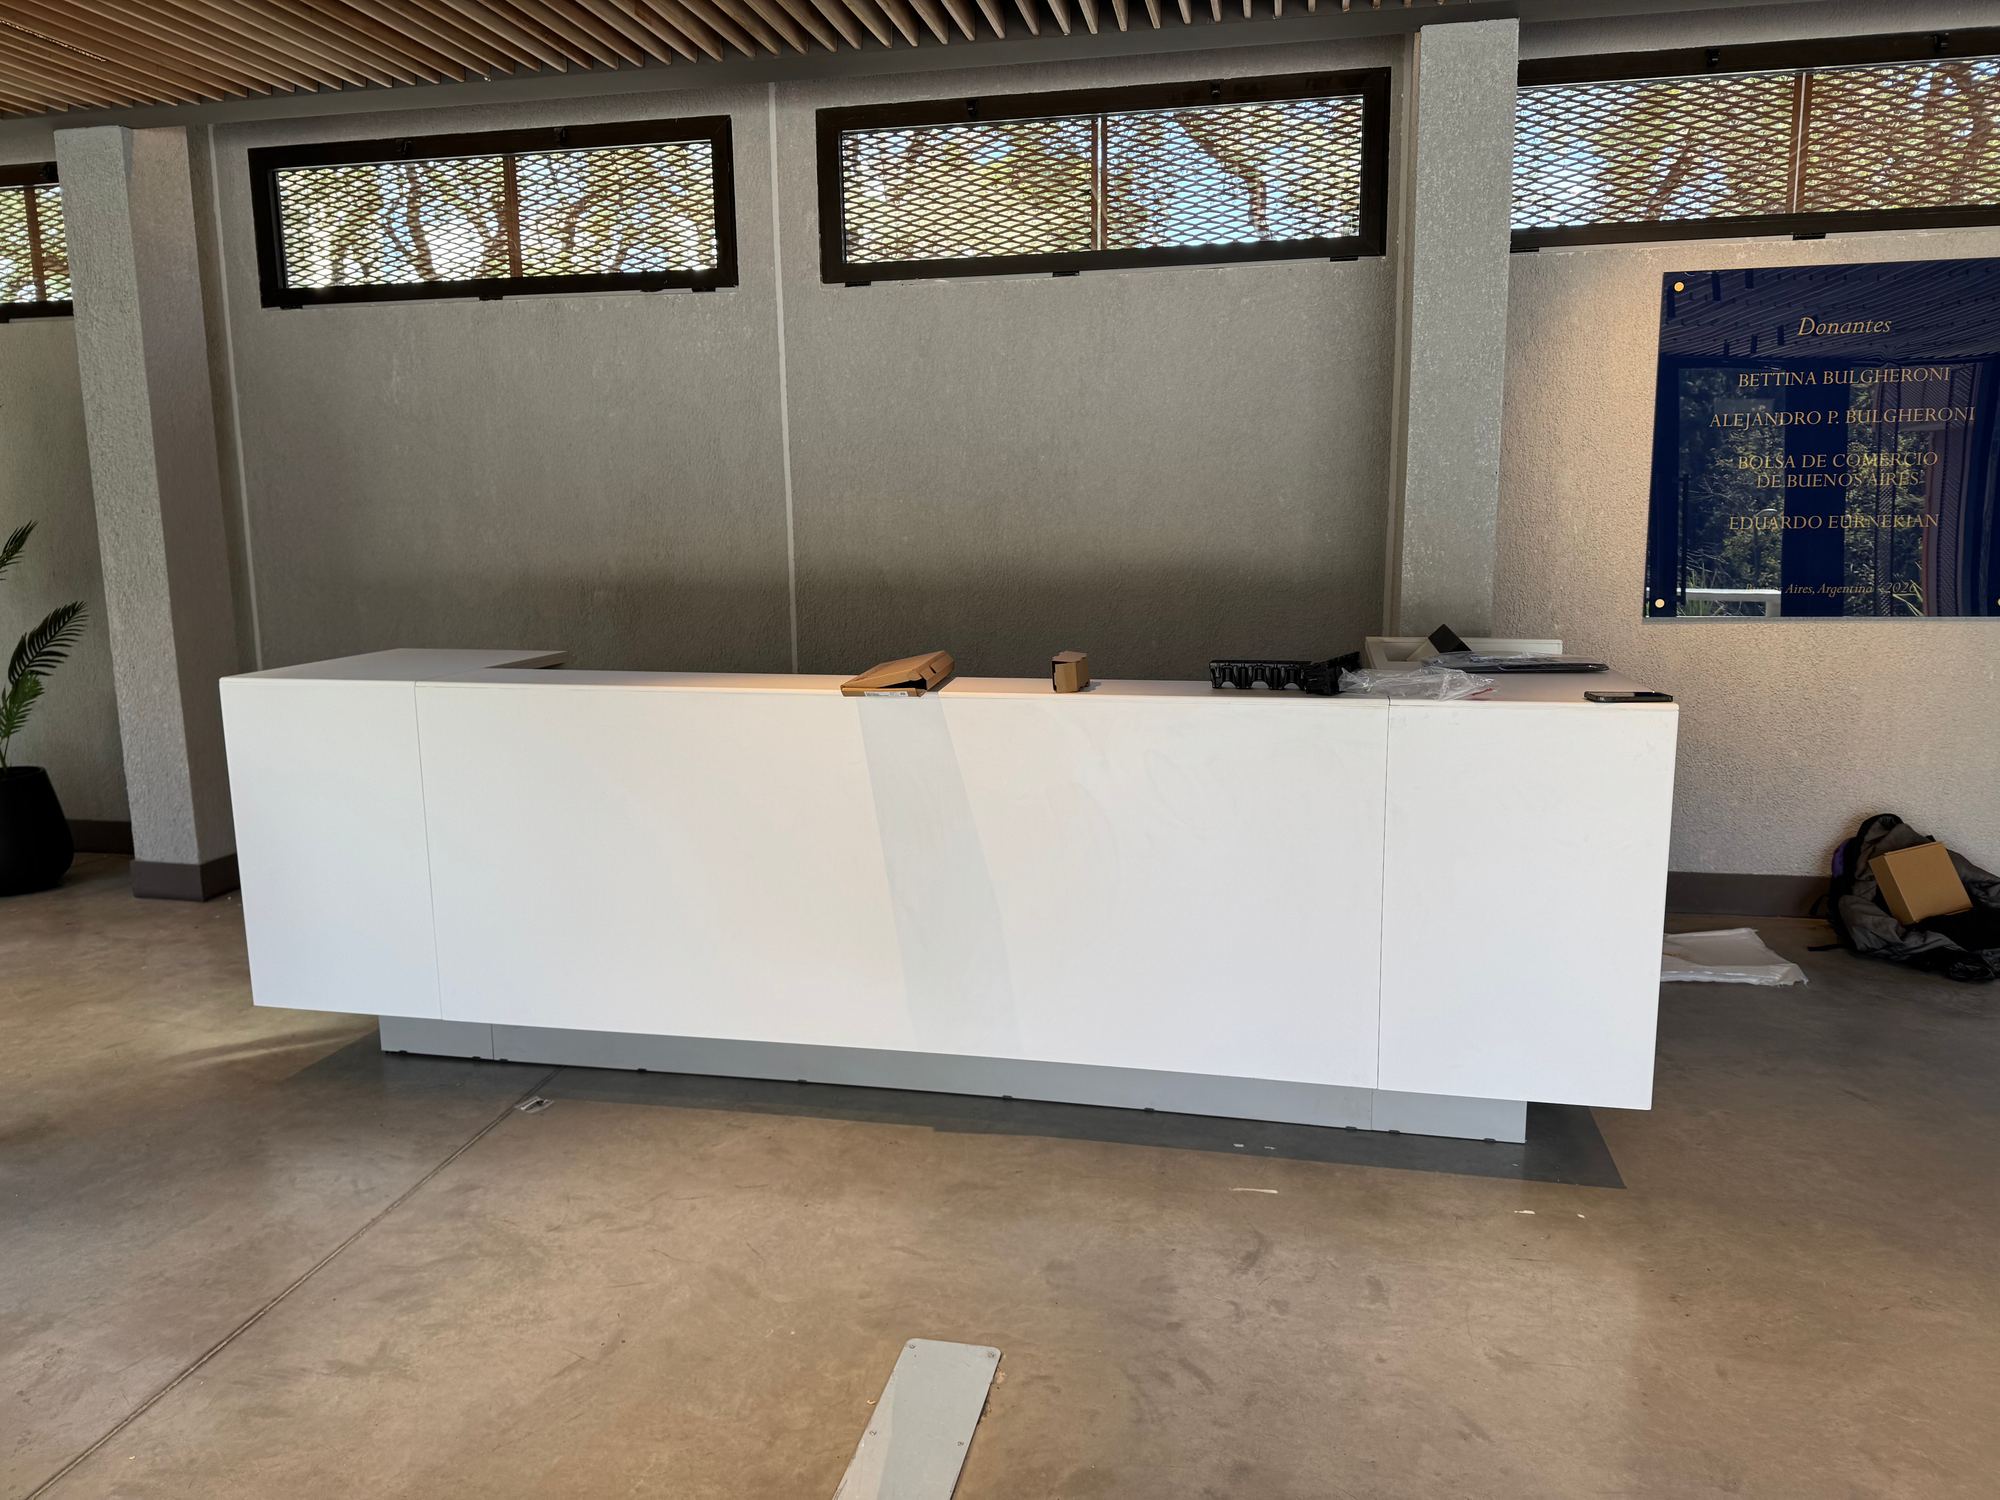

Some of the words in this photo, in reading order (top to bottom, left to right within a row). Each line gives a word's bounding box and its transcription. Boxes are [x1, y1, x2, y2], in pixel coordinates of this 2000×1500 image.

[1797, 316, 1892, 336] Donantes
[1738, 371, 1817, 387] BETTINA
[1822, 367, 1950, 385] BULGHERONI
[1709, 410, 1822, 431] ALEJANDRO
[1827, 410, 1839, 425] P.
[1845, 407, 1976, 424] BULGHERONI
[1738, 455, 1796, 470] BOLSA
[1802, 454, 1827, 468] DE
[1832, 451, 1939, 468] COMERCIO
[1756, 474, 1783, 489] DE
[1787, 472, 1863, 488] BUENOS
[1868, 472, 1919, 486] AIRES
[1729, 515, 1823, 530] EDUARDO
[1828, 514, 1939, 529] EURNEKIAN
[1785, 583, 1815, 595] Aires,
[1817, 583, 1874, 597] Argentina
